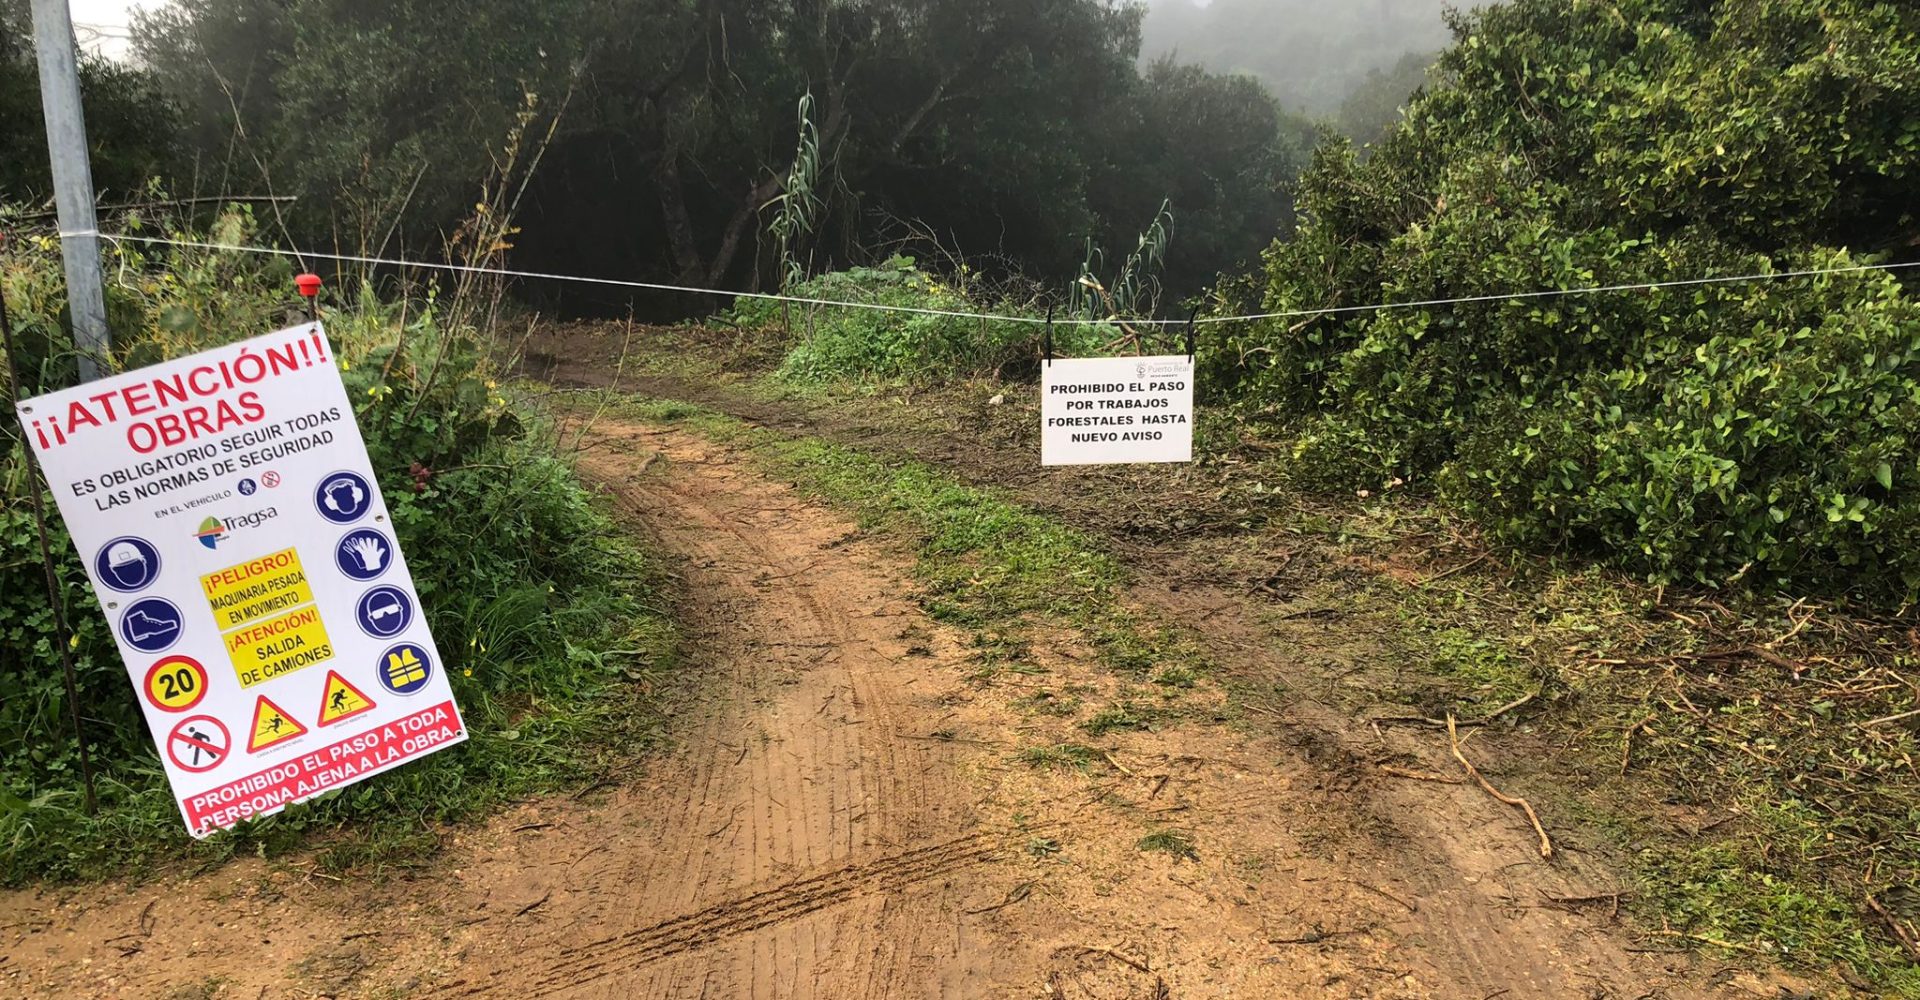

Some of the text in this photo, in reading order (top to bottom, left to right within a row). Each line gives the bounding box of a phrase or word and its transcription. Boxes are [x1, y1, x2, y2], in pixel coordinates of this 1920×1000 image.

[1148, 364, 1189, 373] Puerto Real
[32, 335, 328, 450] ¡¡ATENCIÓN!!
[1050, 381, 1185, 394] PROHIBIDO EL PASO
[1066, 398, 1169, 410] POR TRABAJOS
[126, 391, 266, 455] OBRAS
[1048, 414, 1187, 427] FORESTALES HASTA
[1071, 431, 1163, 443] NUEVO AVISO
[71, 407, 342, 497] ES OBLIGATORIO SEGUIR TODAS
[96, 429, 335, 513] LAS NORMAS DE SEGURIDAD
[154, 490, 232, 519] EN EL VEHICULO
[222, 506, 279, 532] Tragsa
[205, 551, 296, 595] ¡PELIGRO!
[210, 570, 306, 611] MAQUINARIA PESADA
[228, 592, 300, 625] EN MOVIMIENTO
[228, 610, 317, 654] ¡ATENCIÓN!
[256, 637, 306, 661] SALIDA
[159, 667, 196, 701] 20
[241, 645, 332, 687] DE CAMIONES
[192, 762, 301, 814] PROHIBIDO
[303, 750, 327, 771] EL
[329, 730, 382, 762] PASO
[383, 723, 399, 741] A
[398, 708, 448, 735] TODA
[199, 724, 454, 831] PERSONA AJENA A LA OBRA
